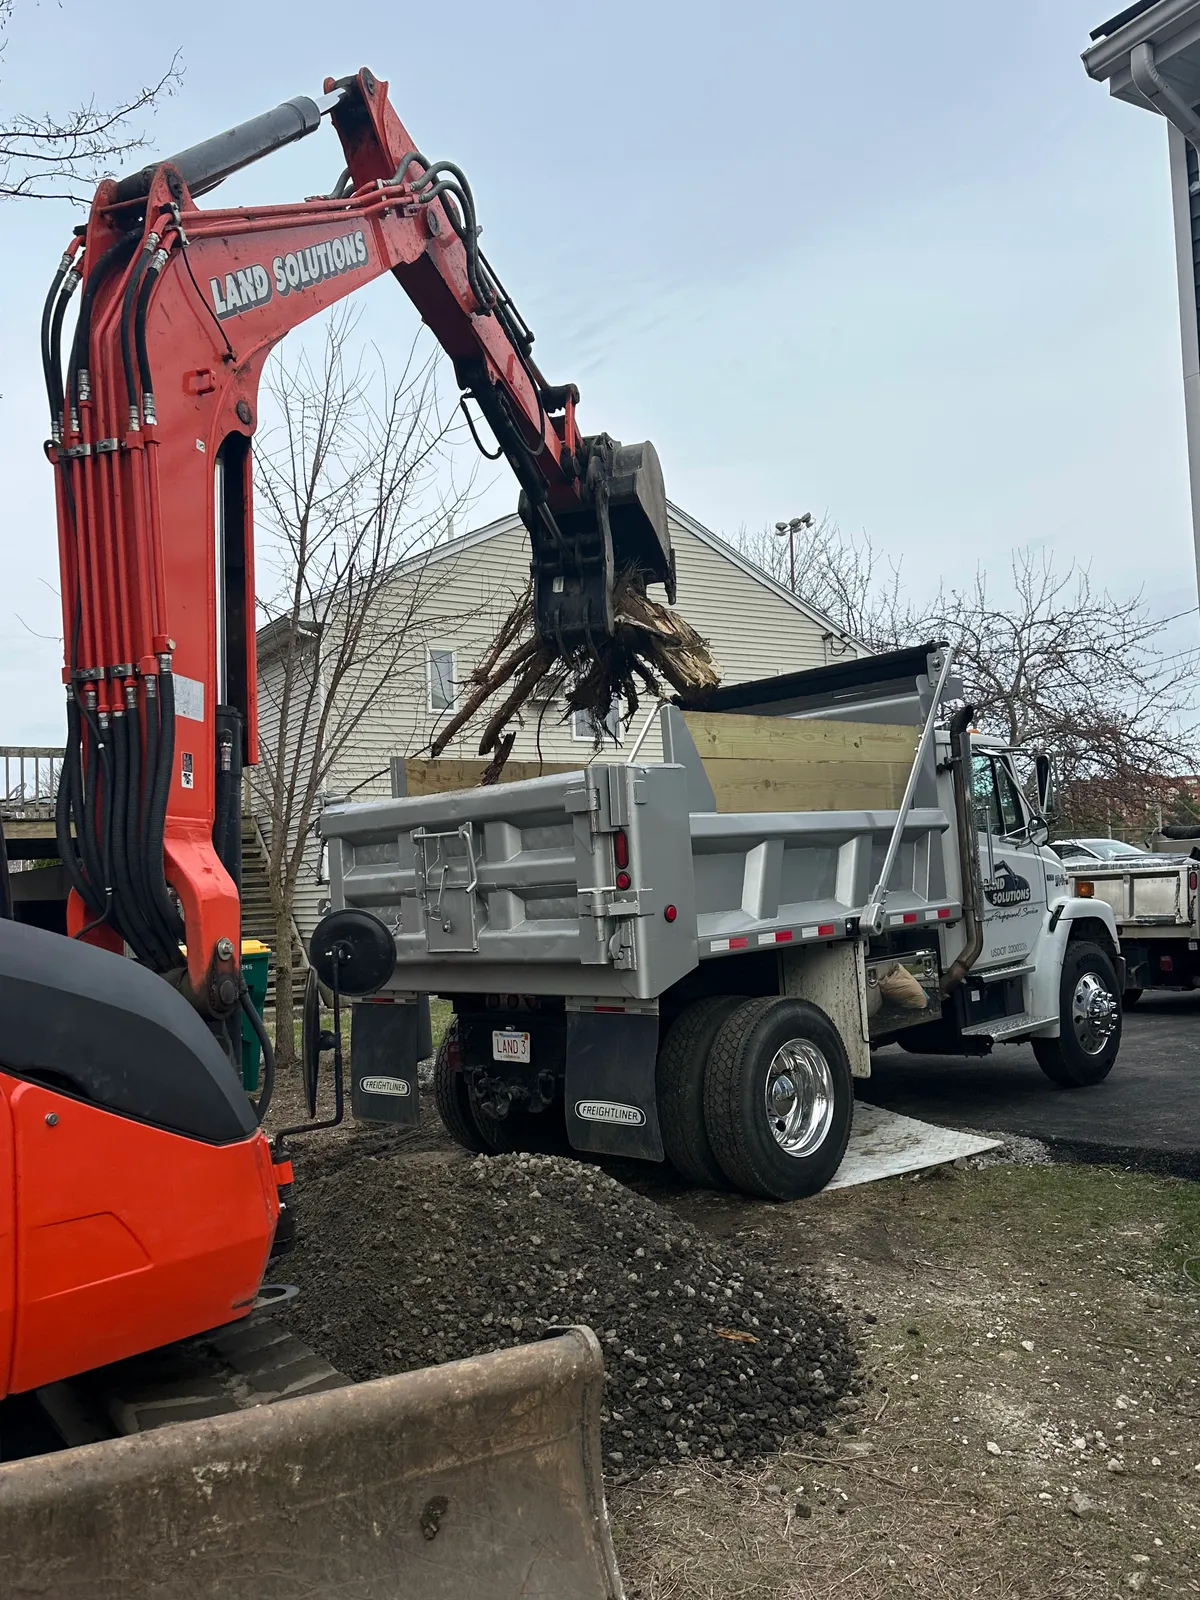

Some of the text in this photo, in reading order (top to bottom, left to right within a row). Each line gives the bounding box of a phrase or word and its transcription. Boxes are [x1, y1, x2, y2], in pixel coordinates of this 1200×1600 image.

[209, 229, 369, 320] LAND SOLUTIONS
[992, 888, 1030, 905] SOLUTIONS
[990, 946, 1007, 957] USDOT
[496, 1039, 526, 1054] LAND 3
[365, 1080, 406, 1092] FREIGHTLINER
[582, 1105, 638, 1121] FREIGHTLINER
